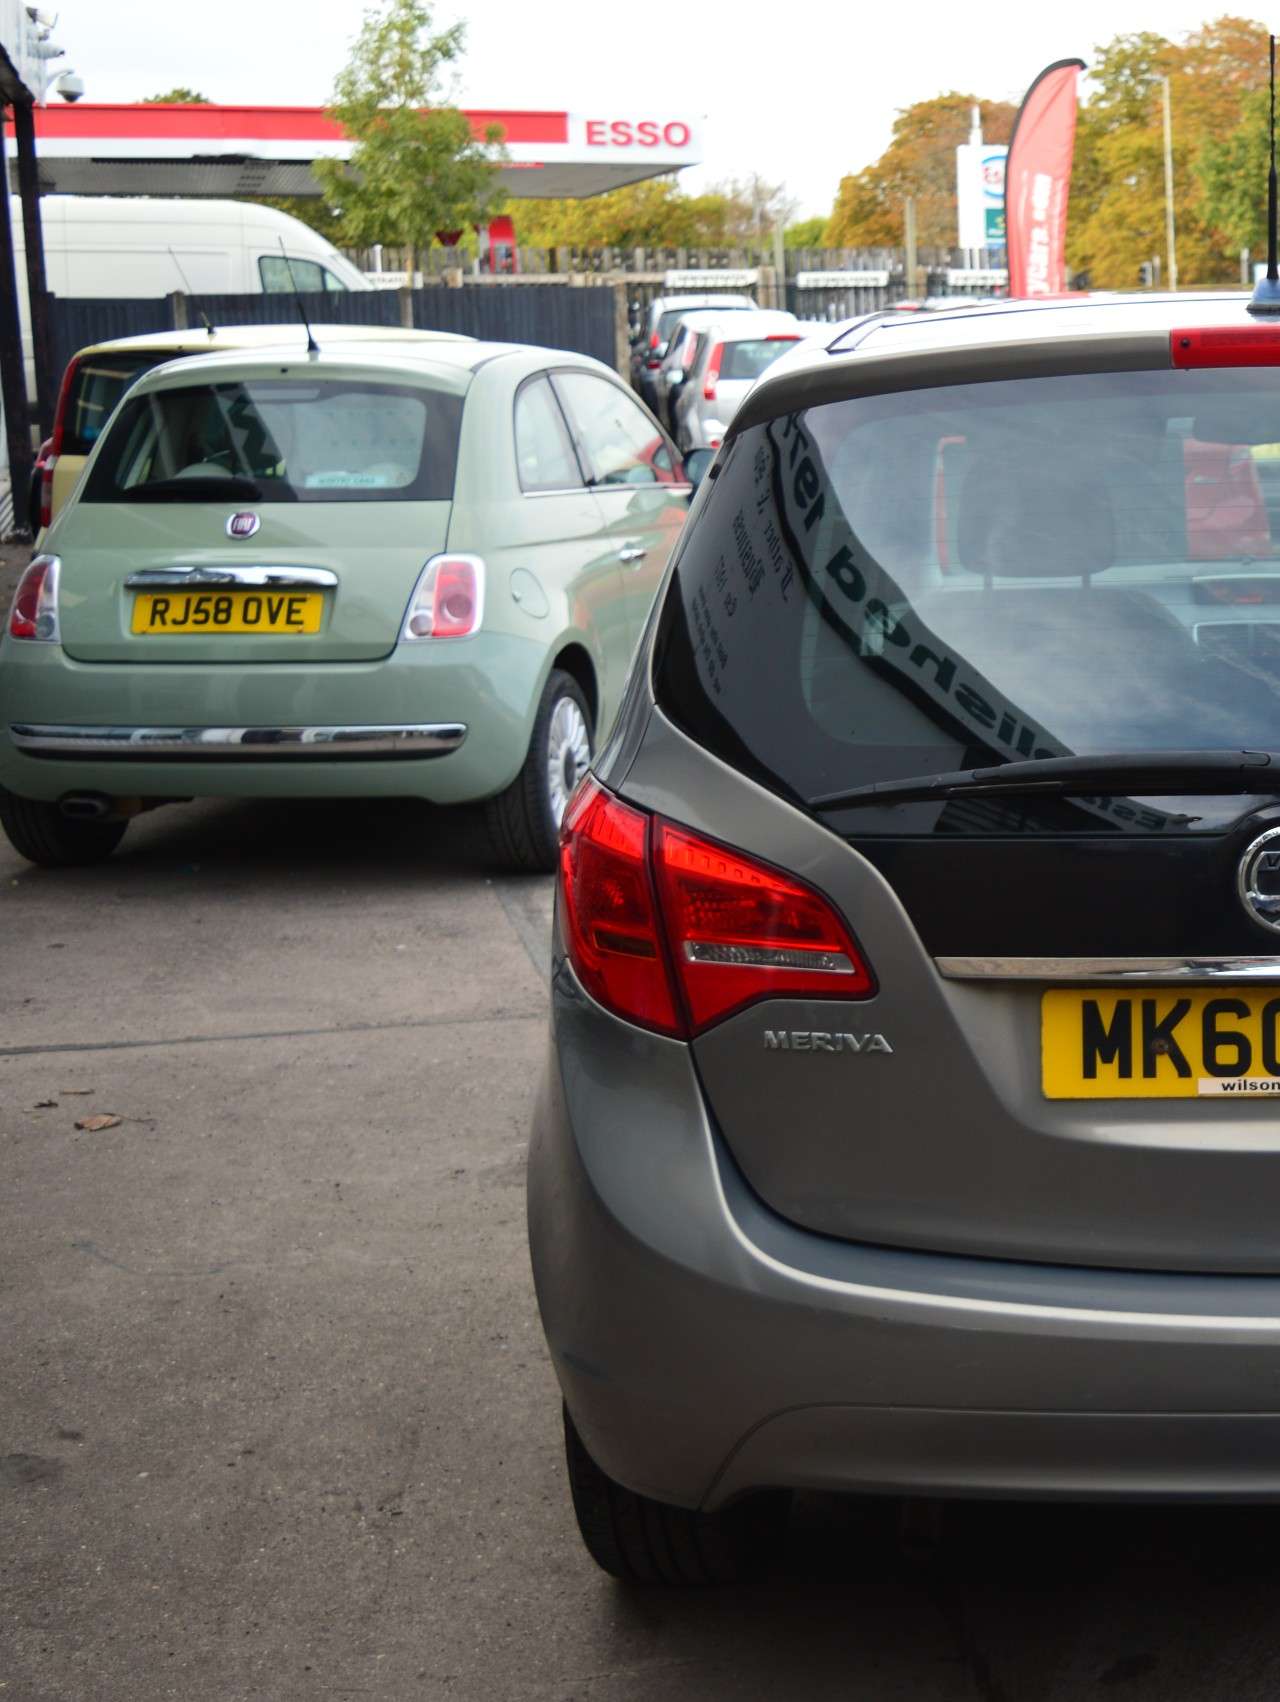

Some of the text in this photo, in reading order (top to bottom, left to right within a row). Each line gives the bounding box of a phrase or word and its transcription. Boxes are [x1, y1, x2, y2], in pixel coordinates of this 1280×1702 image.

[585, 120, 691, 147] ESSO
[233, 517, 254, 531] FIAT
[150, 596, 308, 627] RJ58 OVE
[763, 1030, 894, 1053] MERIVA
